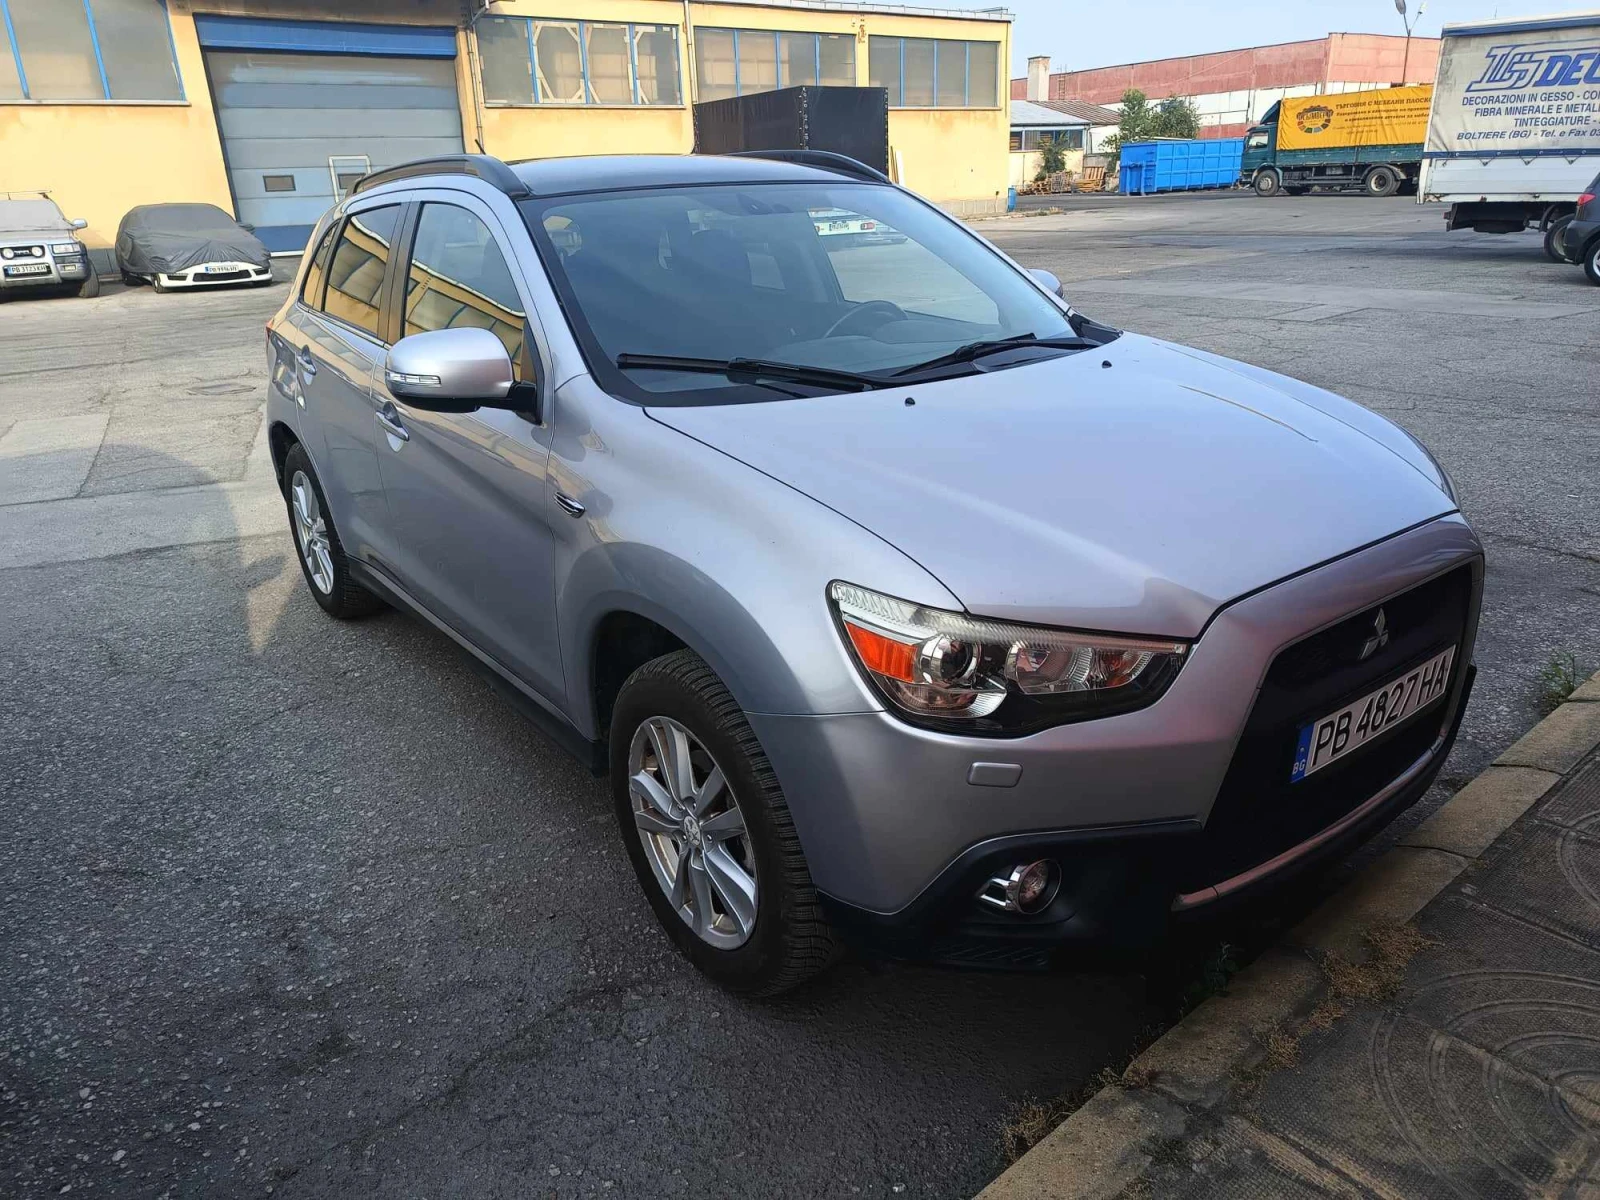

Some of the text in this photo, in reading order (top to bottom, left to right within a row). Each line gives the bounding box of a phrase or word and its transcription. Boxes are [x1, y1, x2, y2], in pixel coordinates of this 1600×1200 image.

[1462, 94, 1526, 106] DECORAZIONI
[1528, 93, 1538, 103] IN
[1540, 91, 1575, 102] GESSO
[1583, 90, 1600, 100] CO
[1474, 107, 1502, 117] FIBRA
[1504, 104, 1554, 115] MINERALE
[1556, 104, 1563, 113] E
[1514, 116, 1591, 127] TINTEGGIATURE
[1457, 131, 1507, 140] BOLTIERE
[1508, 129, 1531, 139] (BG)
[1540, 129, 1556, 138] Tel.
[1568, 128, 1588, 137] Fax
[1311, 655, 1447, 767] PB 4827 HA
[1292, 758, 1306, 775] BG
